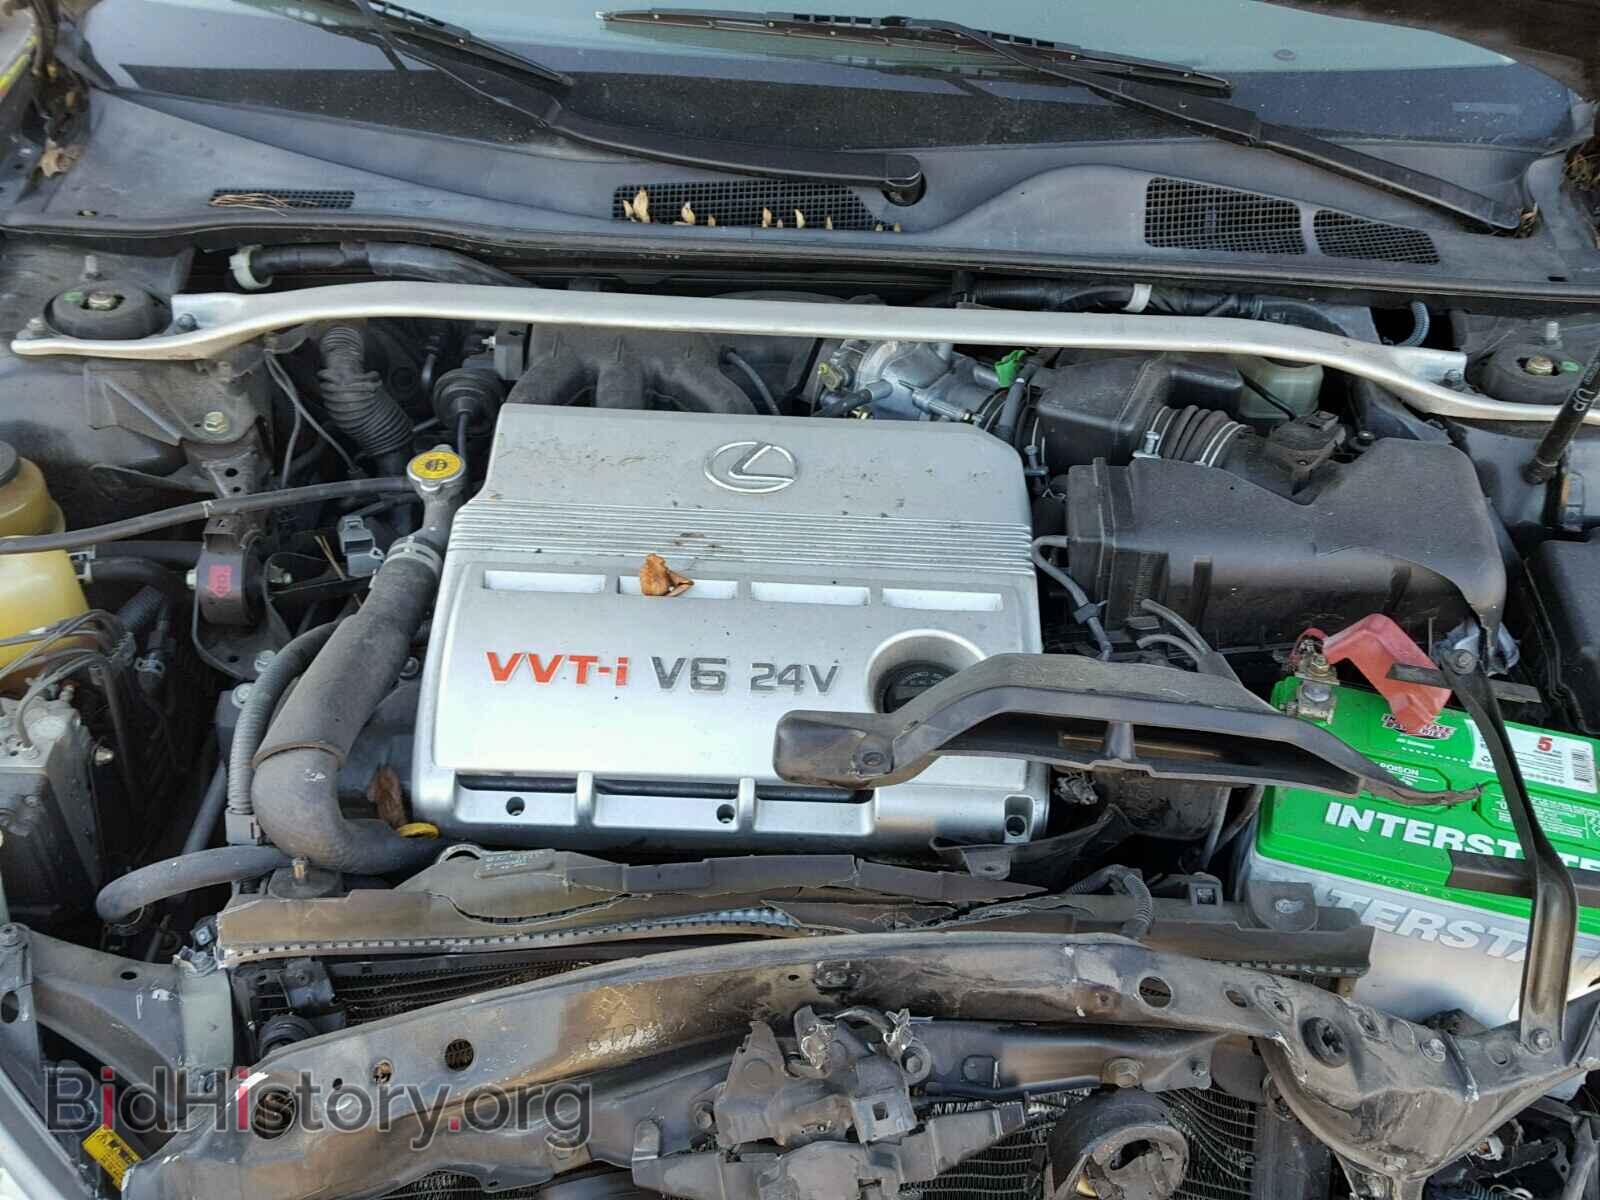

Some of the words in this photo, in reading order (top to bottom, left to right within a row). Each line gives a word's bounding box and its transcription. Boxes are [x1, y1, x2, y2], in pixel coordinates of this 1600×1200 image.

[485, 650, 630, 688] VVT-i
[650, 655, 728, 694] V6
[750, 660, 839, 695] 24V
[1325, 801, 1600, 873] INTERST
[1328, 889, 1530, 963] TERST
